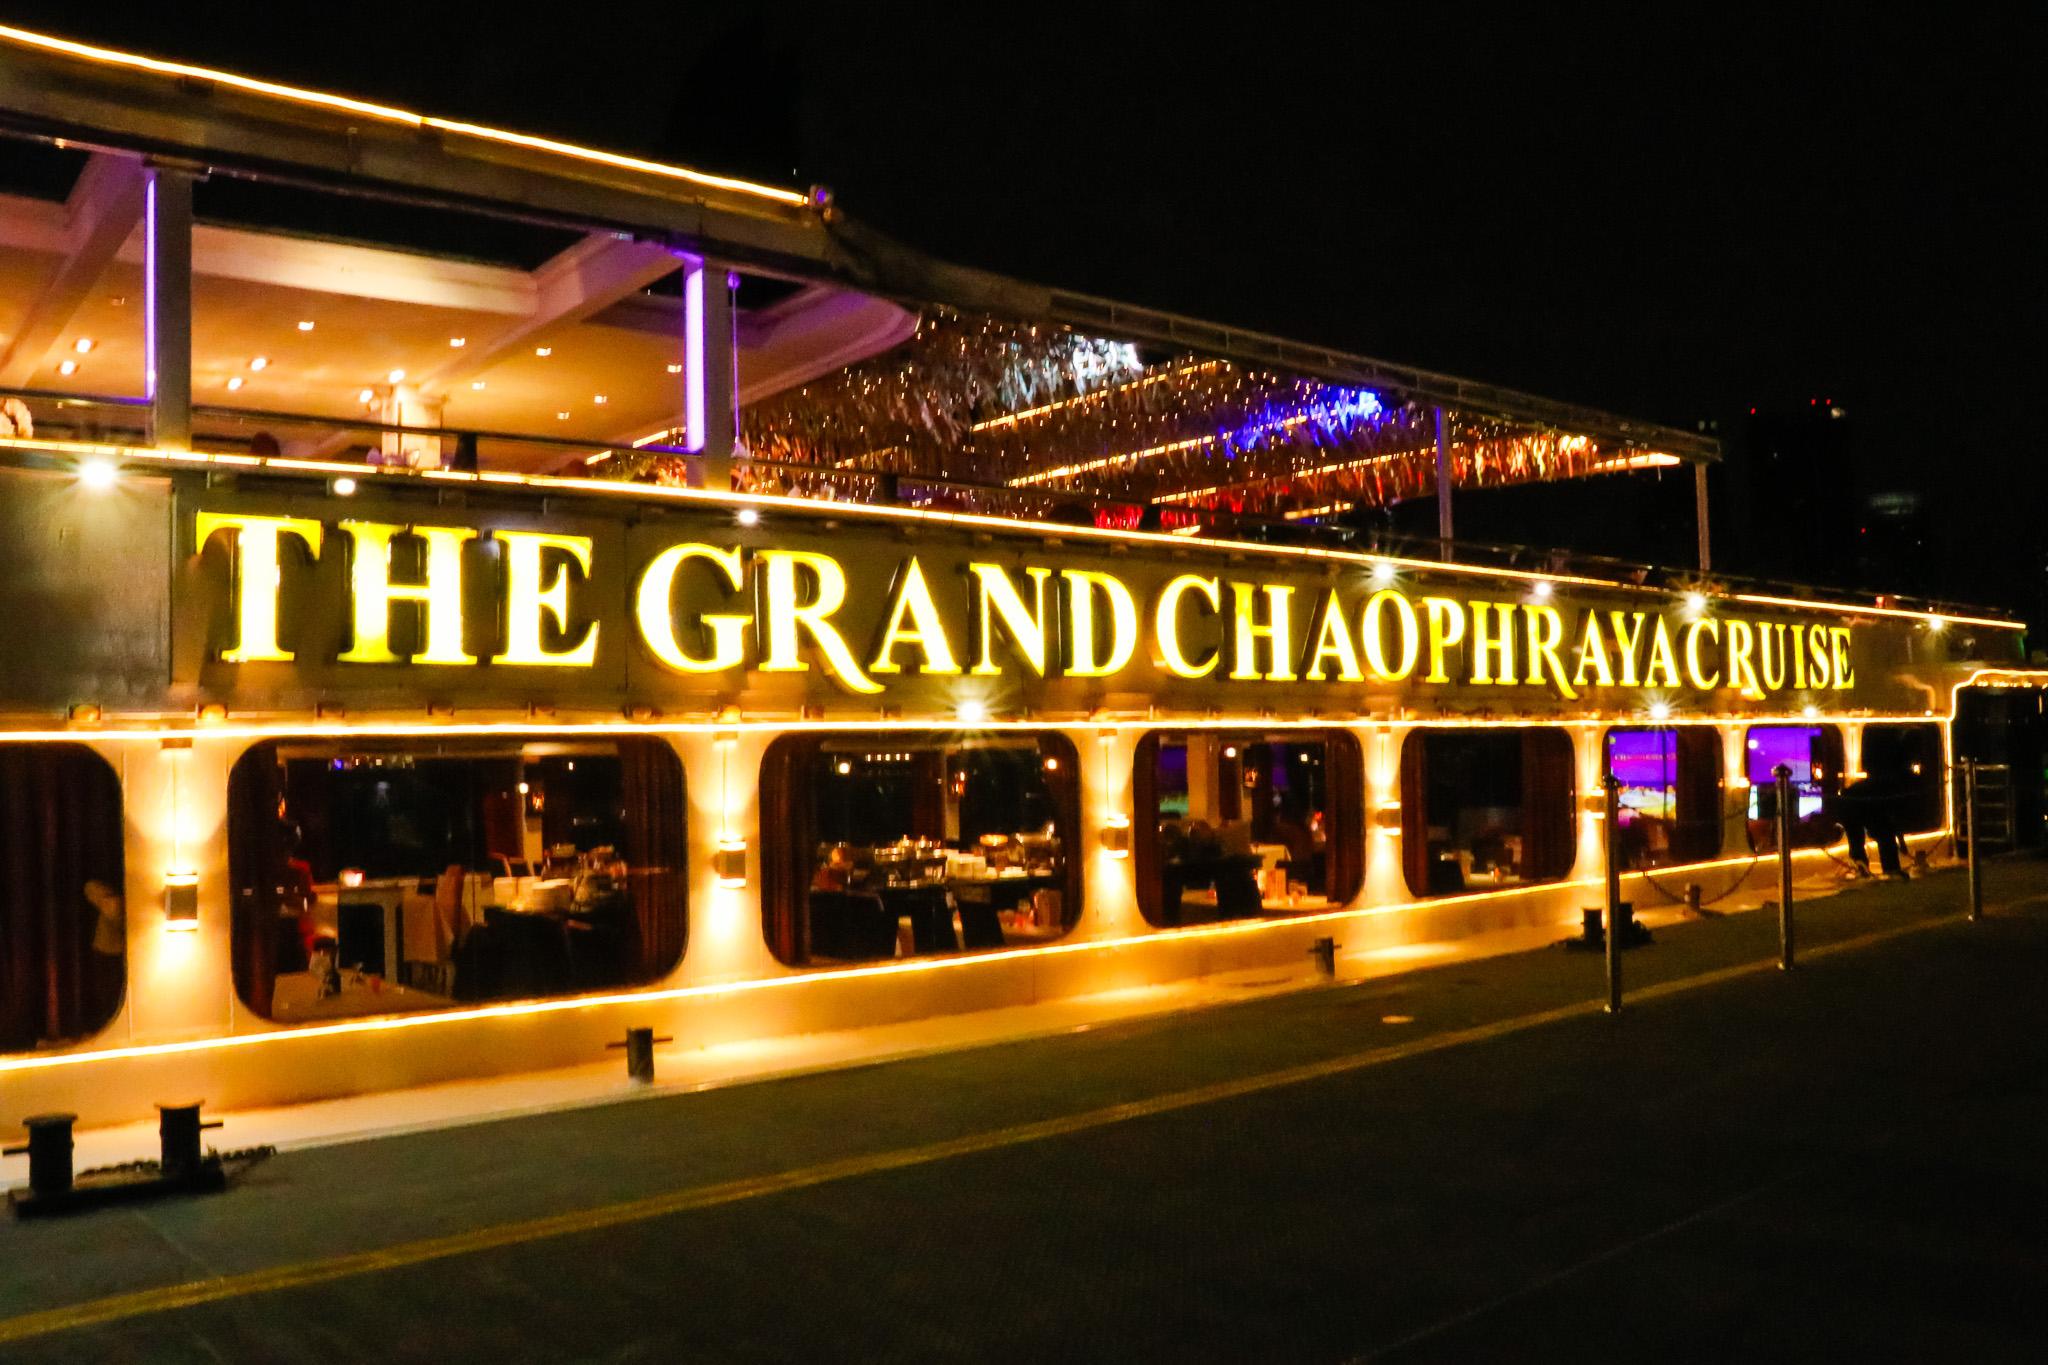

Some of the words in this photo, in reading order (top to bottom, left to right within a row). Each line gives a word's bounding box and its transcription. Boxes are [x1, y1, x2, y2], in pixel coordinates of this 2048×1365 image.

[195, 510, 598, 667] THE
[636, 542, 1137, 694] GRAND
[1686, 617, 1854, 700] CRUISE
